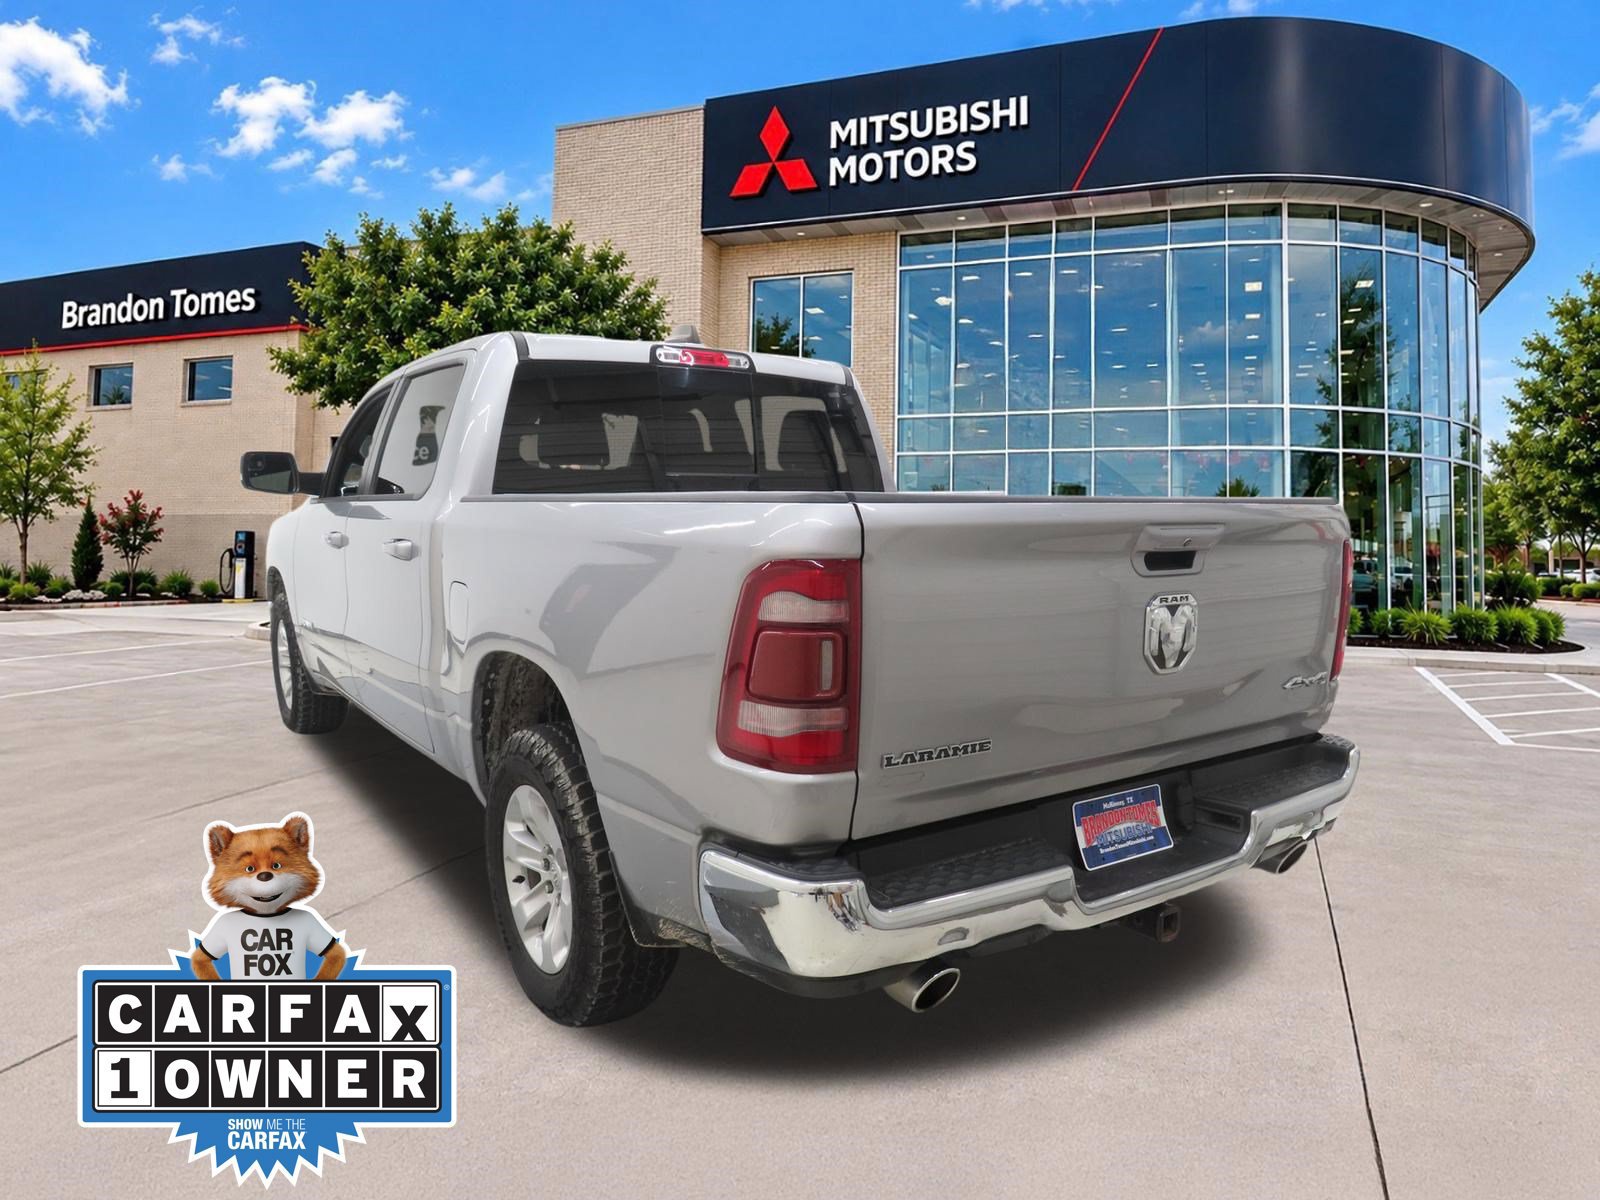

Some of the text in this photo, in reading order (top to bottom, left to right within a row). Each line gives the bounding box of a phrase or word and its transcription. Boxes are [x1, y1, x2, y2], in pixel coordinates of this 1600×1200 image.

[830, 95, 1029, 149] MITSUBISHI
[829, 141, 977, 187] MOTORS
[61, 288, 256, 329] Brandon Tomes
[1159, 595, 1189, 604] RAM
[883, 739, 992, 769] LARAMIE
[1096, 822, 1153, 847] MITSUBISHI
